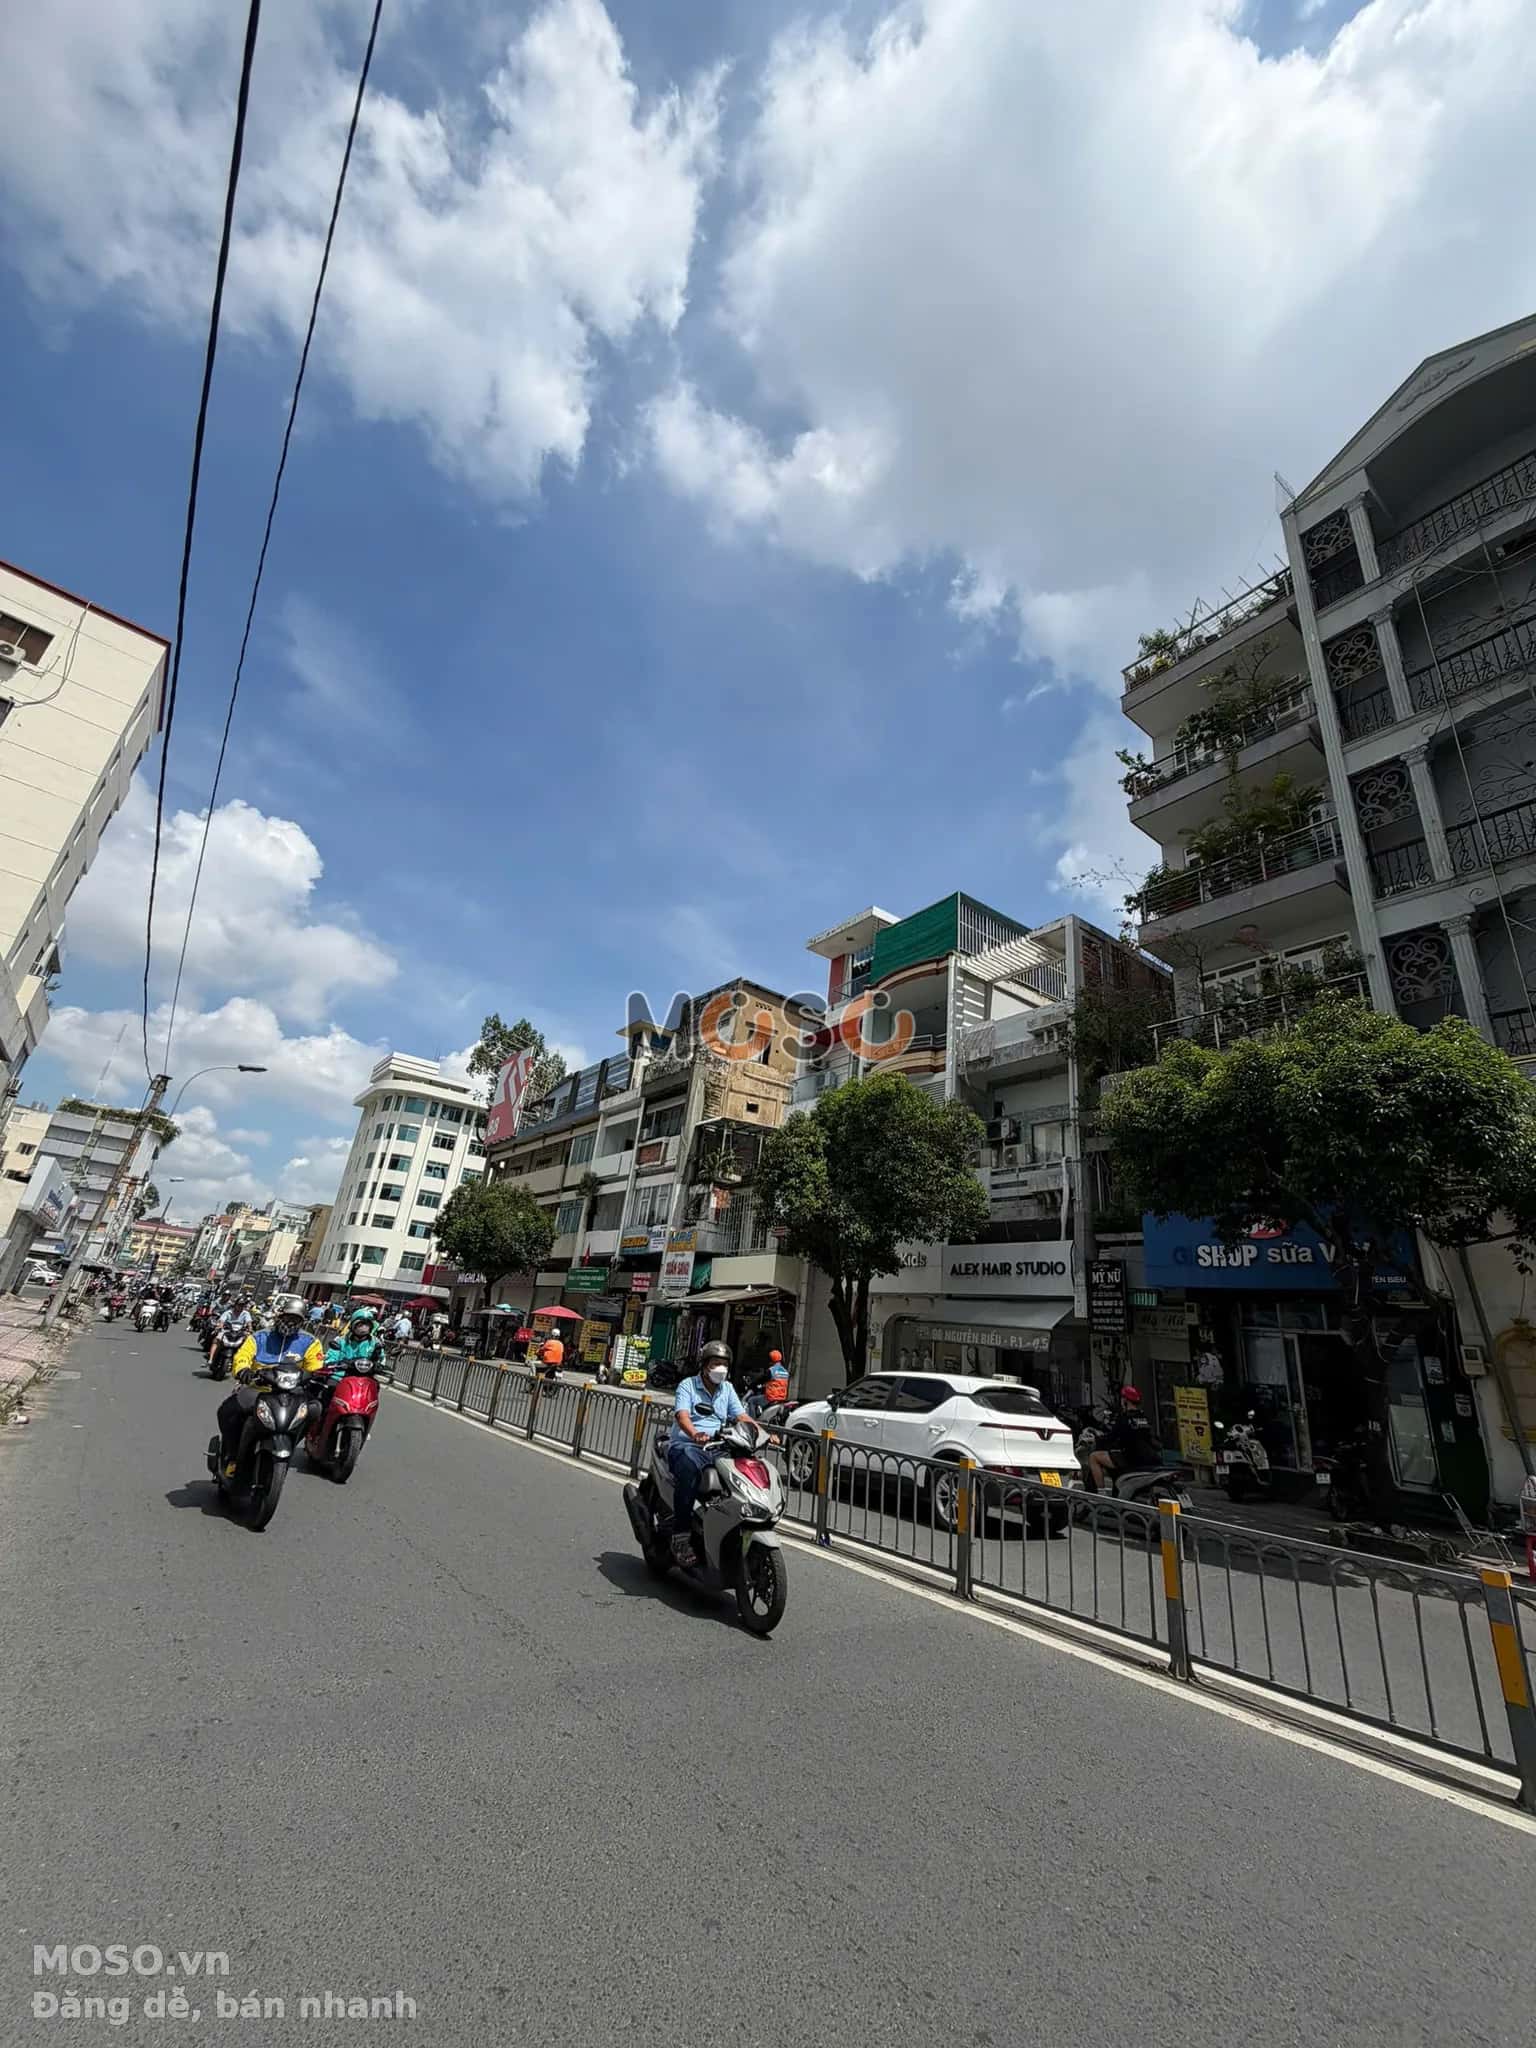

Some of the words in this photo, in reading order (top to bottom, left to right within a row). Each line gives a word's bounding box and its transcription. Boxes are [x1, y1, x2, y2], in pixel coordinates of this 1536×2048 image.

[1267, 1242, 1314, 1264] sữa
[950, 1262, 980, 1276] ALEX
[982, 1262, 1012, 1276] HAIR
[1015, 1261, 1066, 1275] STUDIO
